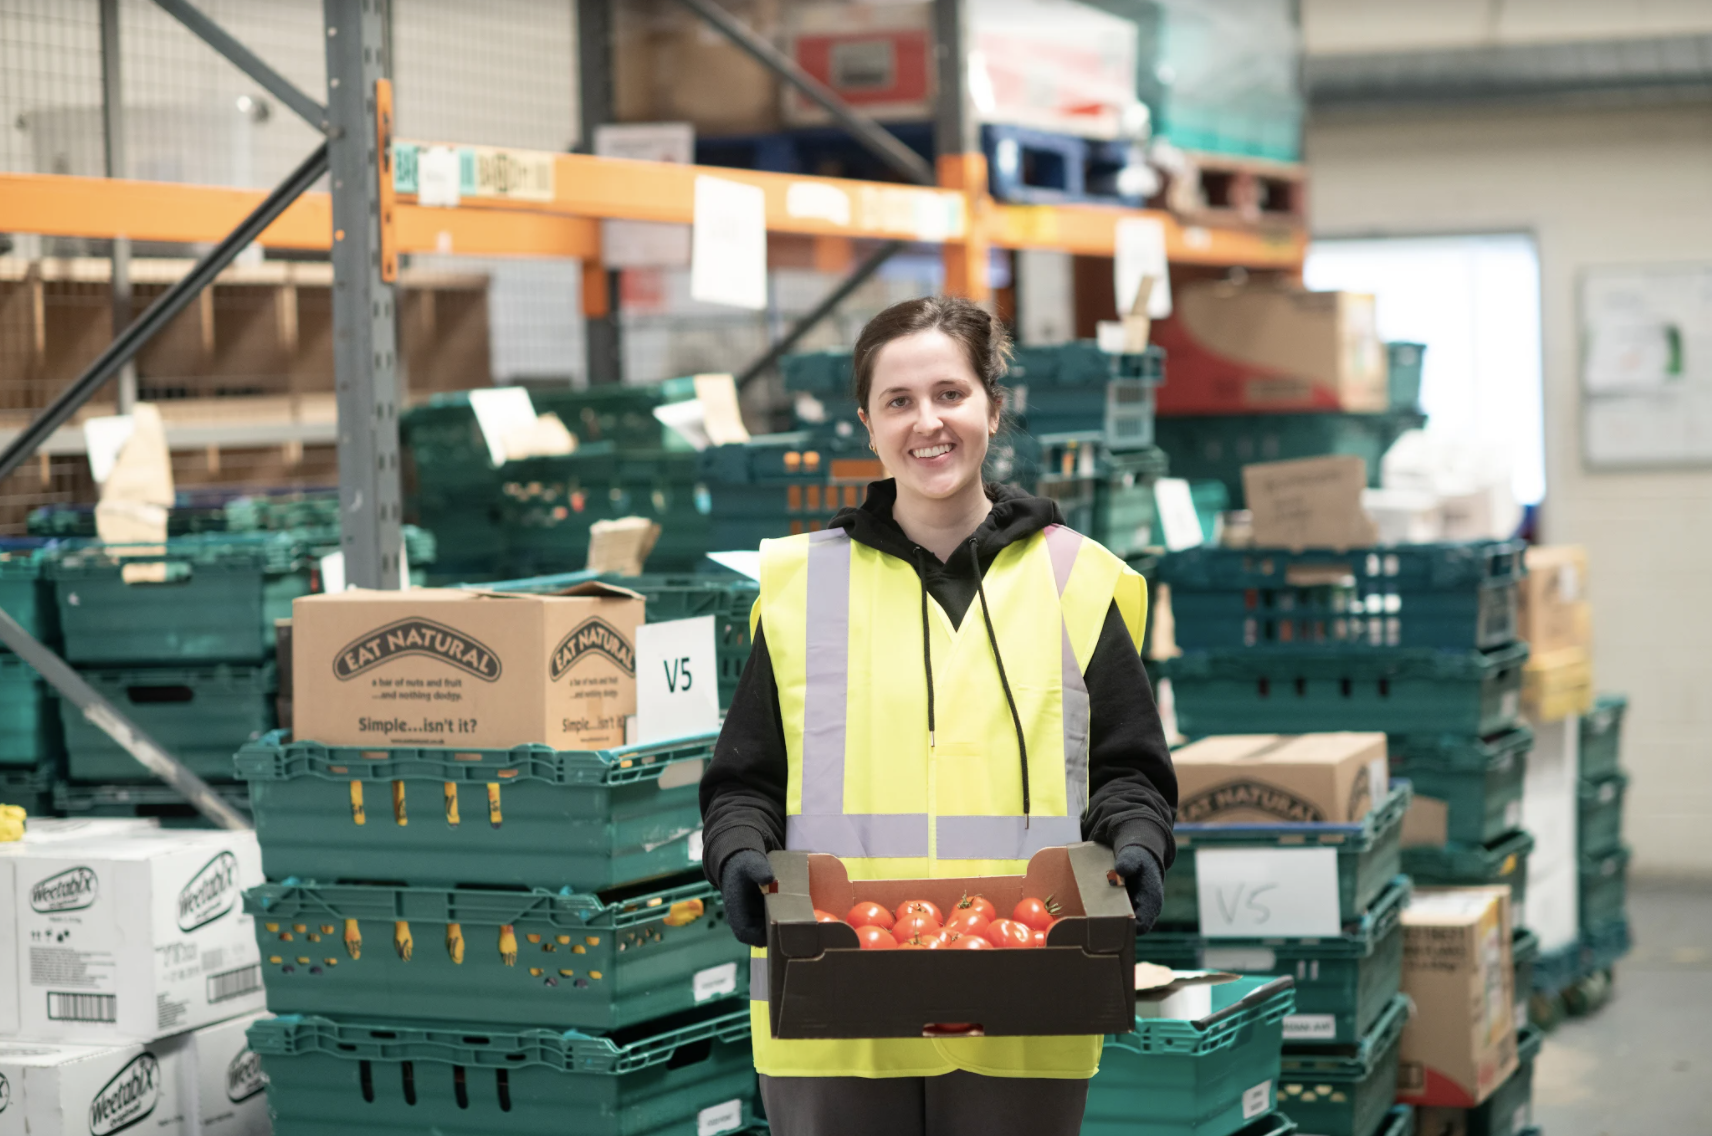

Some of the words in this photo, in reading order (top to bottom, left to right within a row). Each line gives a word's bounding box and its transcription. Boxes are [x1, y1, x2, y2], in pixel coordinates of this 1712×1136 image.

[343, 638, 381, 671] EAT
[386, 627, 489, 673] NATURAL
[555, 638, 577, 671] EAT
[578, 627, 634, 669] NATURAL
[379, 678, 392, 687] bar
[395, 678, 404, 687] of
[406, 679, 424, 687] nuts
[426, 678, 442, 687] and
[444, 678, 462, 687] fruit
[664, 657, 693, 693] V5
[399, 690, 432, 702] nothing
[358, 717, 454, 734] Simple...isn't
[458, 718, 478, 733] it?
[33, 868, 94, 903] Weetabix
[179, 854, 234, 919] Weetabix
[91, 1055, 157, 1127] Weetabix
